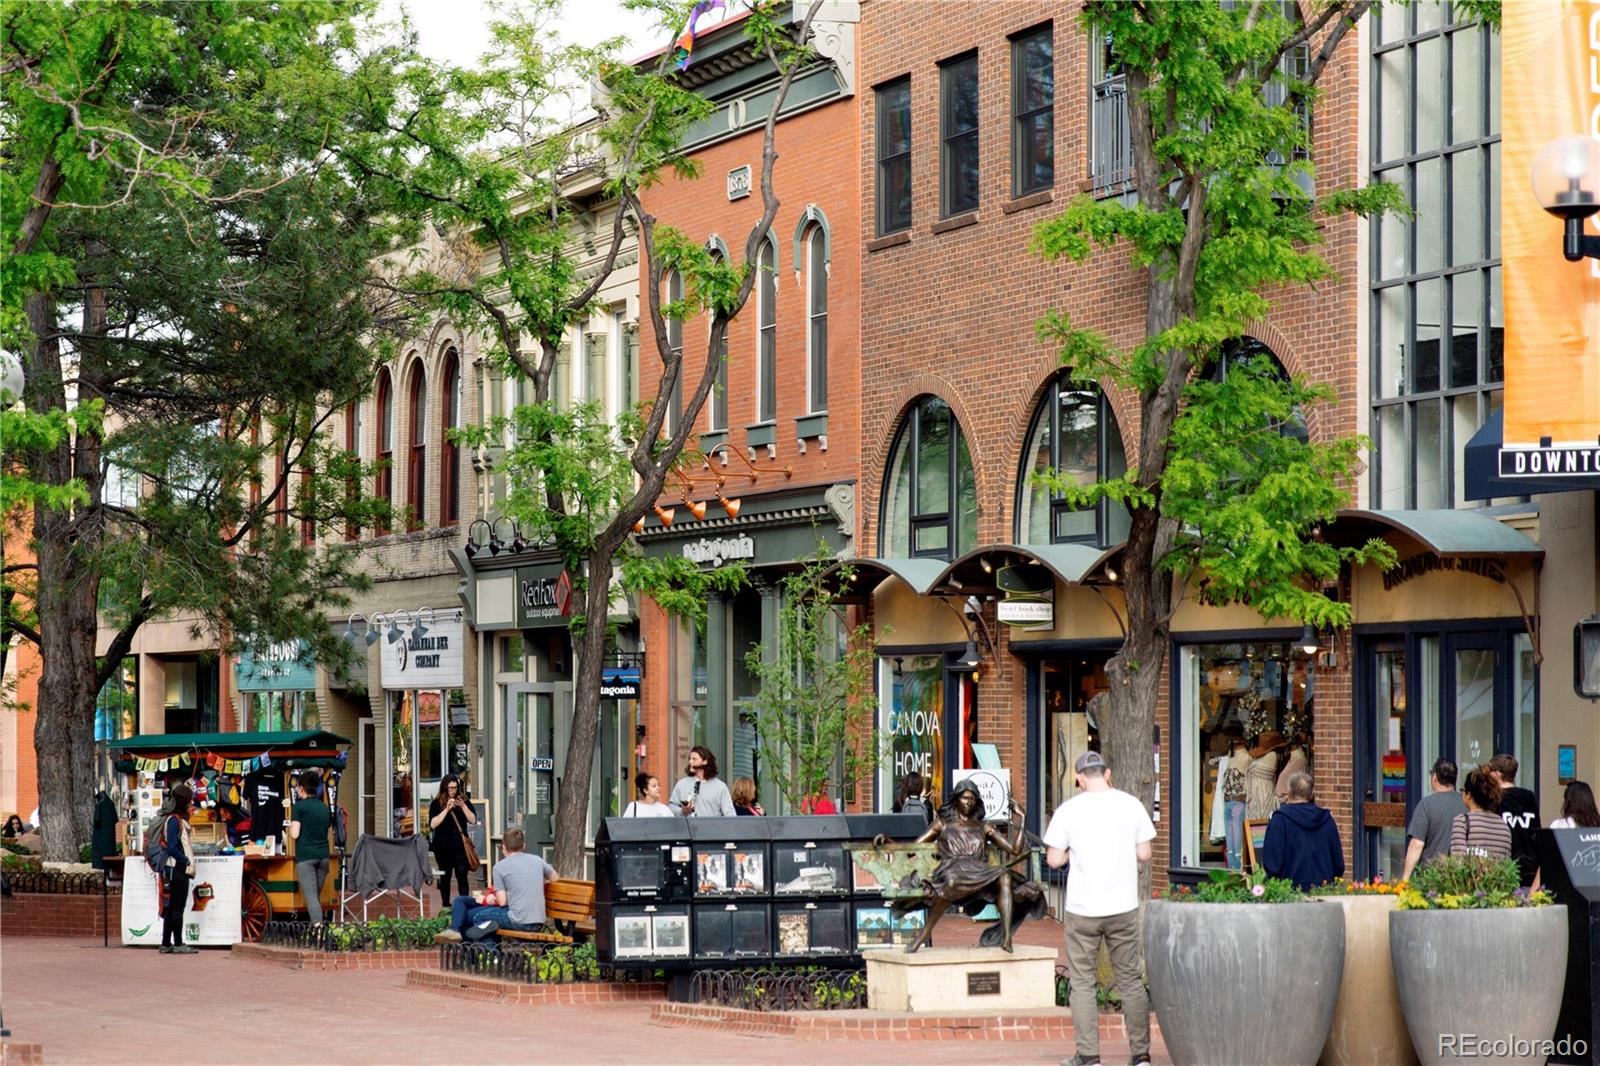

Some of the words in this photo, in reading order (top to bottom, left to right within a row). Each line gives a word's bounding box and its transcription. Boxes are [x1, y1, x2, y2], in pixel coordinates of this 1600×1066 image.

[522, 578, 557, 607] RedFox
[600, 685, 636, 697] tagonia
[888, 711, 941, 736] CANOVA
[532, 759, 552, 769] OPEN
[895, 751, 932, 777] HOME
